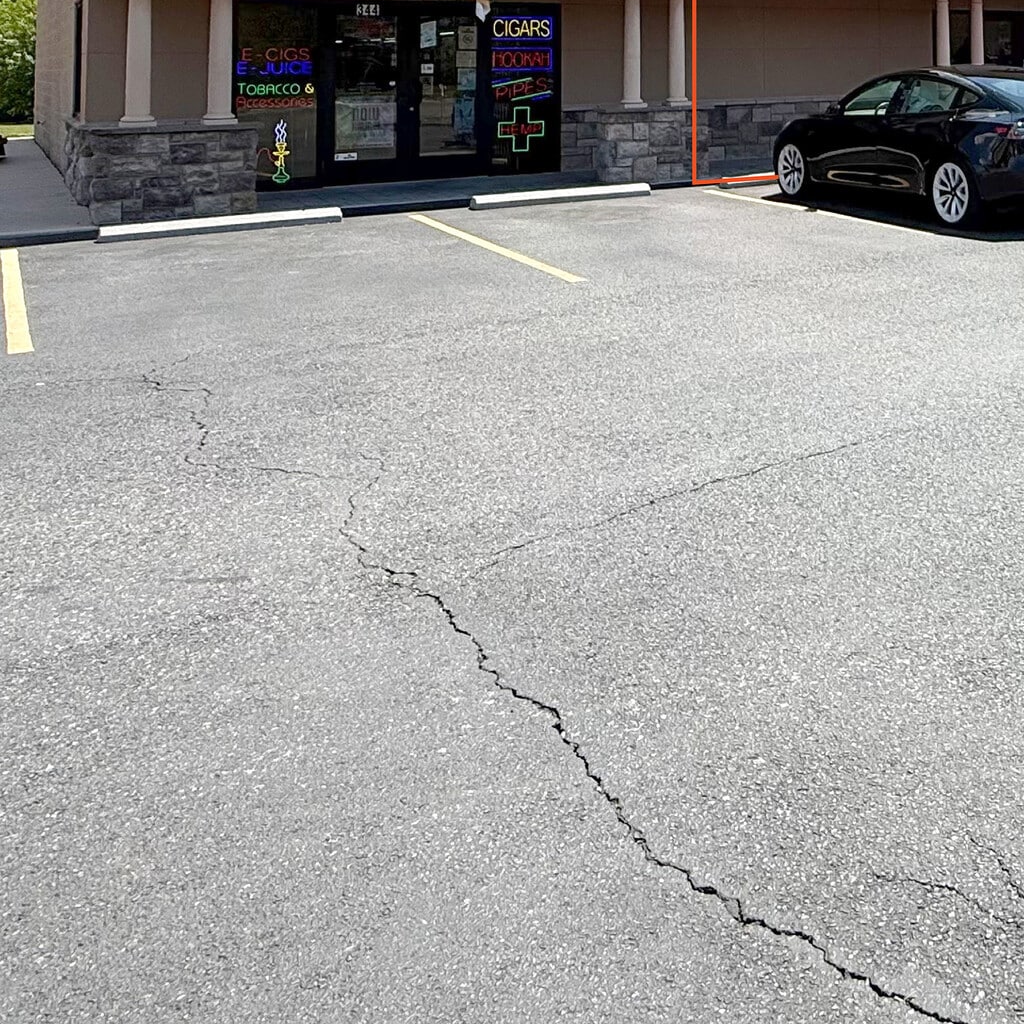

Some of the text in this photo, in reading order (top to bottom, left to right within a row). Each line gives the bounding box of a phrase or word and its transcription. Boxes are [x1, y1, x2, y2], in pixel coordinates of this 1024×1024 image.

[493, 19, 550, 37] CIGARS
[241, 48, 310, 61] E-CIGS
[492, 51, 550, 67] HOOKAH
[236, 61, 313, 74] E-JUICE
[237, 83, 315, 95] TOBACCO &
[496, 77, 547, 101] PIPES
[236, 96, 314, 109] Accessories
[501, 123, 542, 136] HEMP
